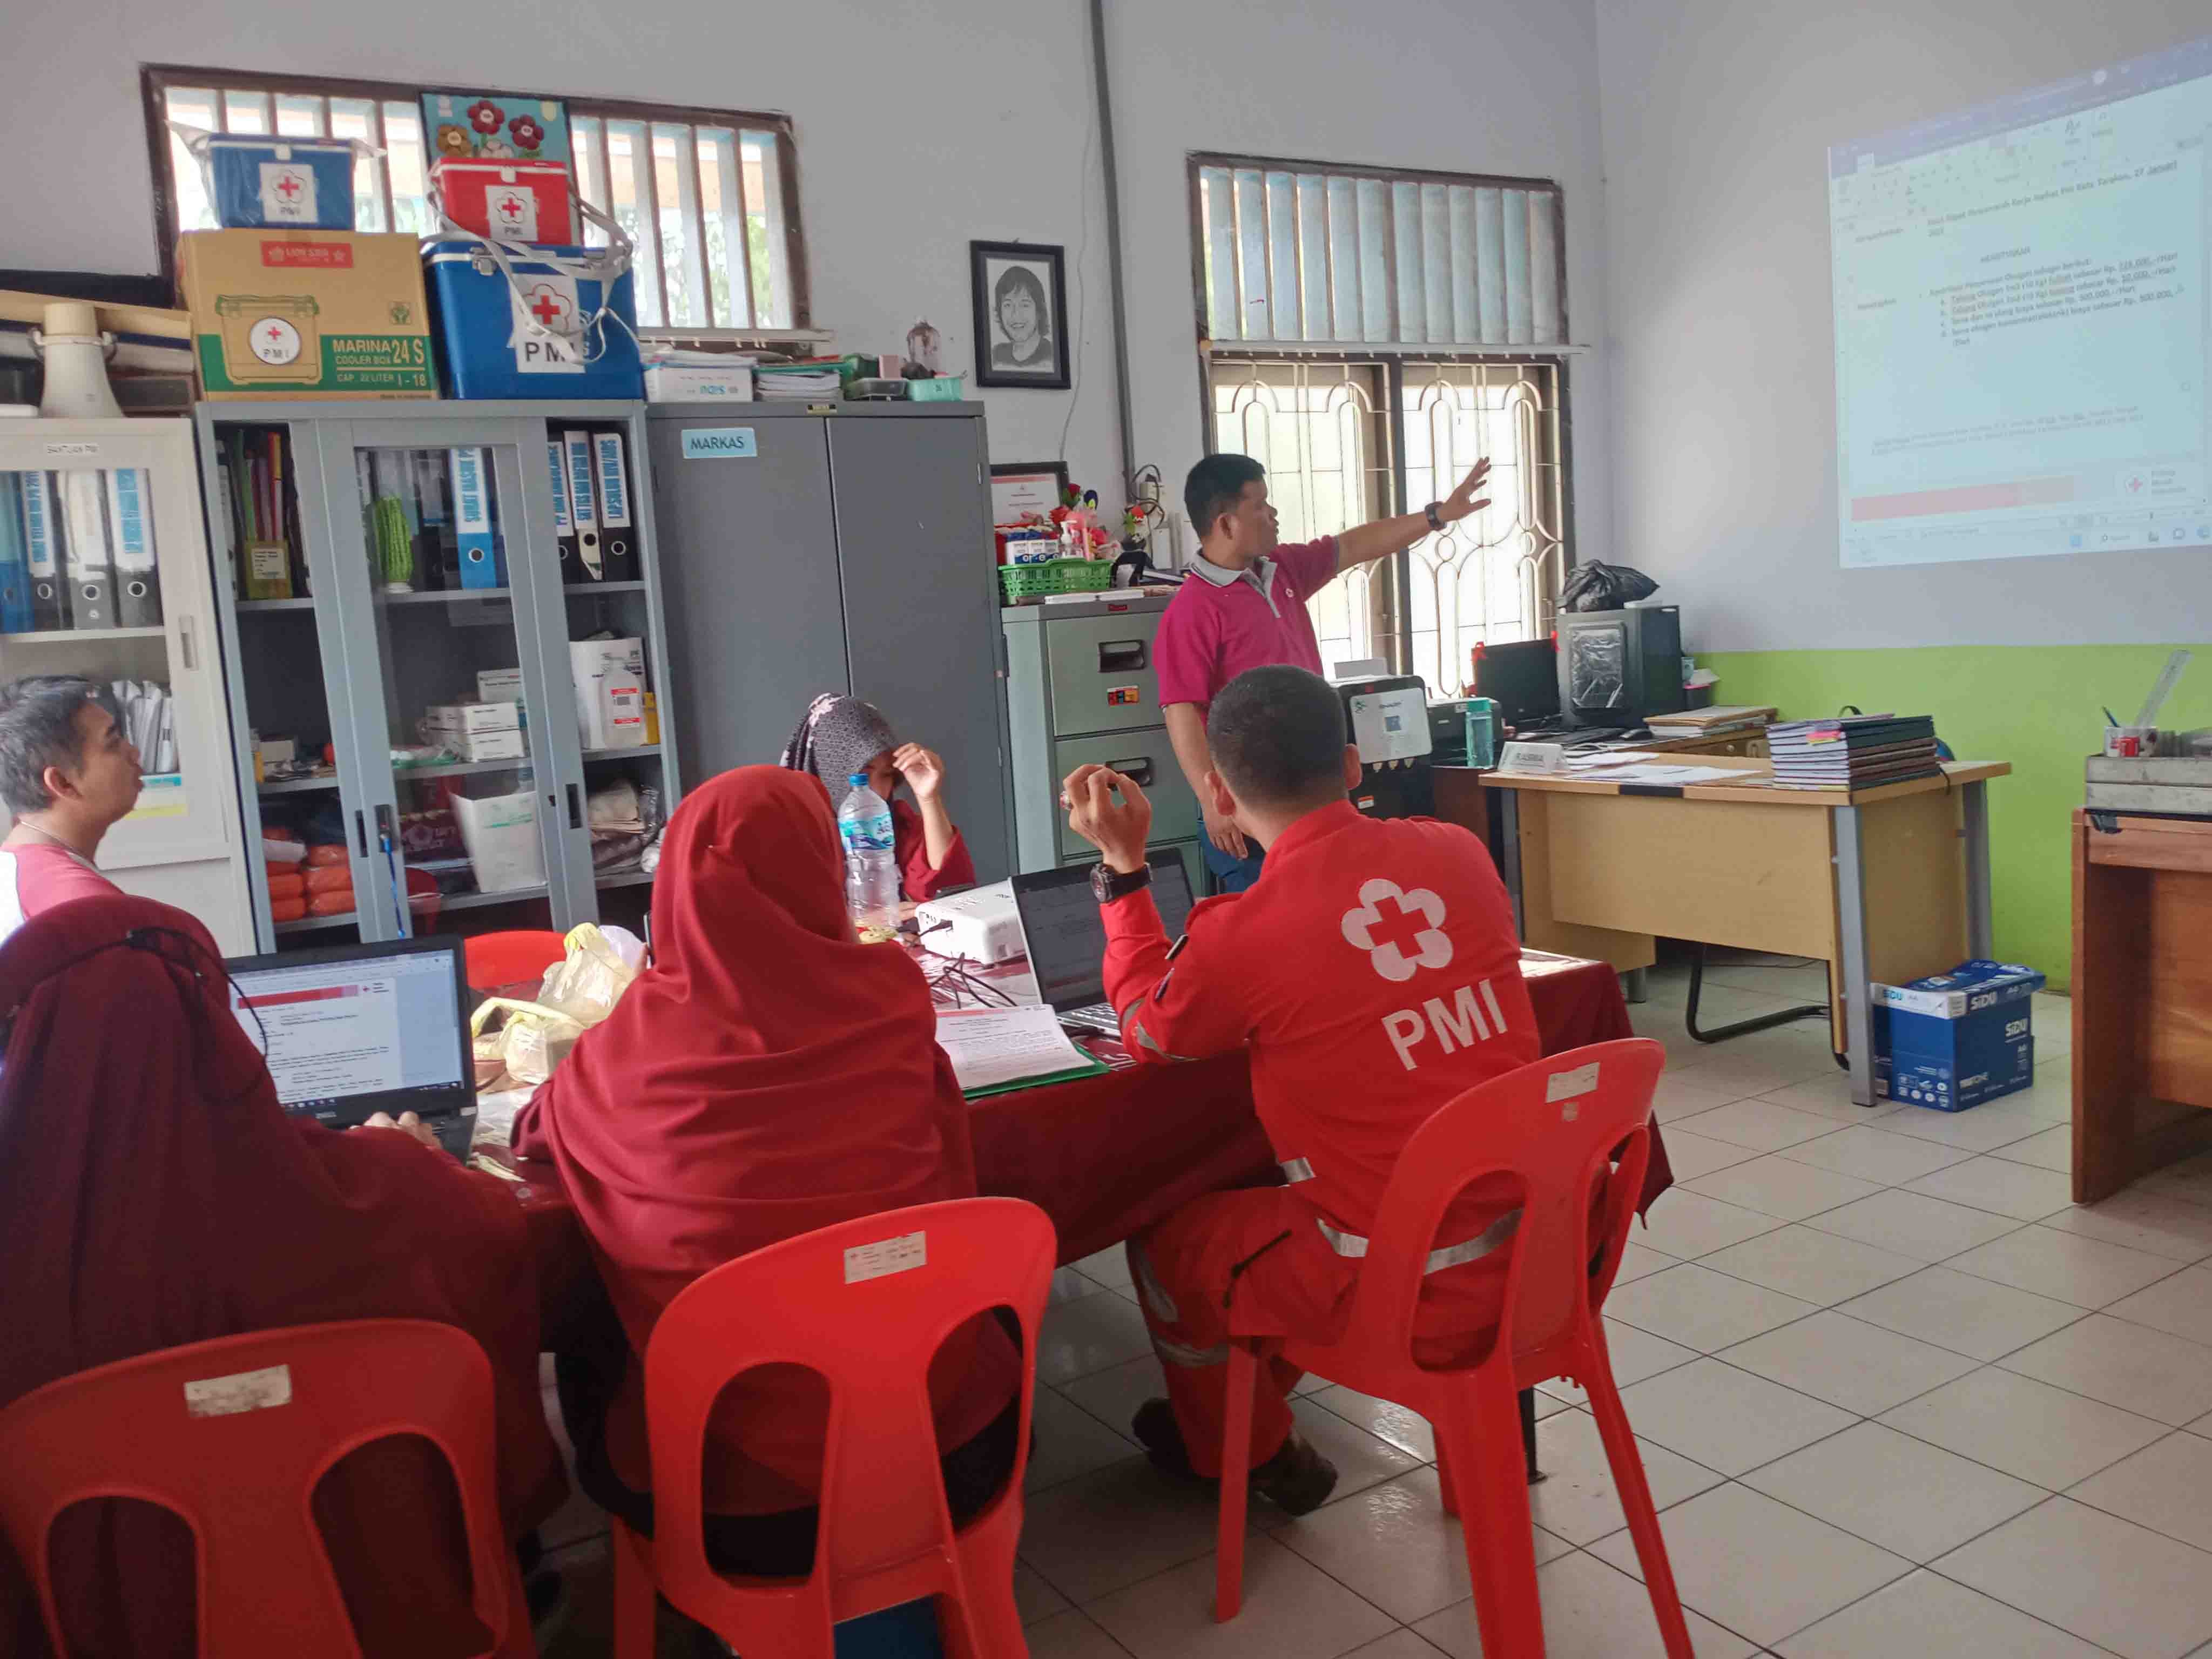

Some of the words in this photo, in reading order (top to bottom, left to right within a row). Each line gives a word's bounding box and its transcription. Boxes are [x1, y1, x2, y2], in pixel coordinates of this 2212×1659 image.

[504, 226, 522, 234] PMI
[264, 348, 289, 359] PMI
[333, 339, 393, 353] MARINA
[392, 338, 410, 364] 24
[412, 338, 424, 364] S
[524, 341, 576, 362] PM
[334, 355, 372, 365] COOLER
[373, 355, 391, 365] BOX
[691, 436, 744, 449] MARKAS
[1381, 979, 1508, 1071] PMI
